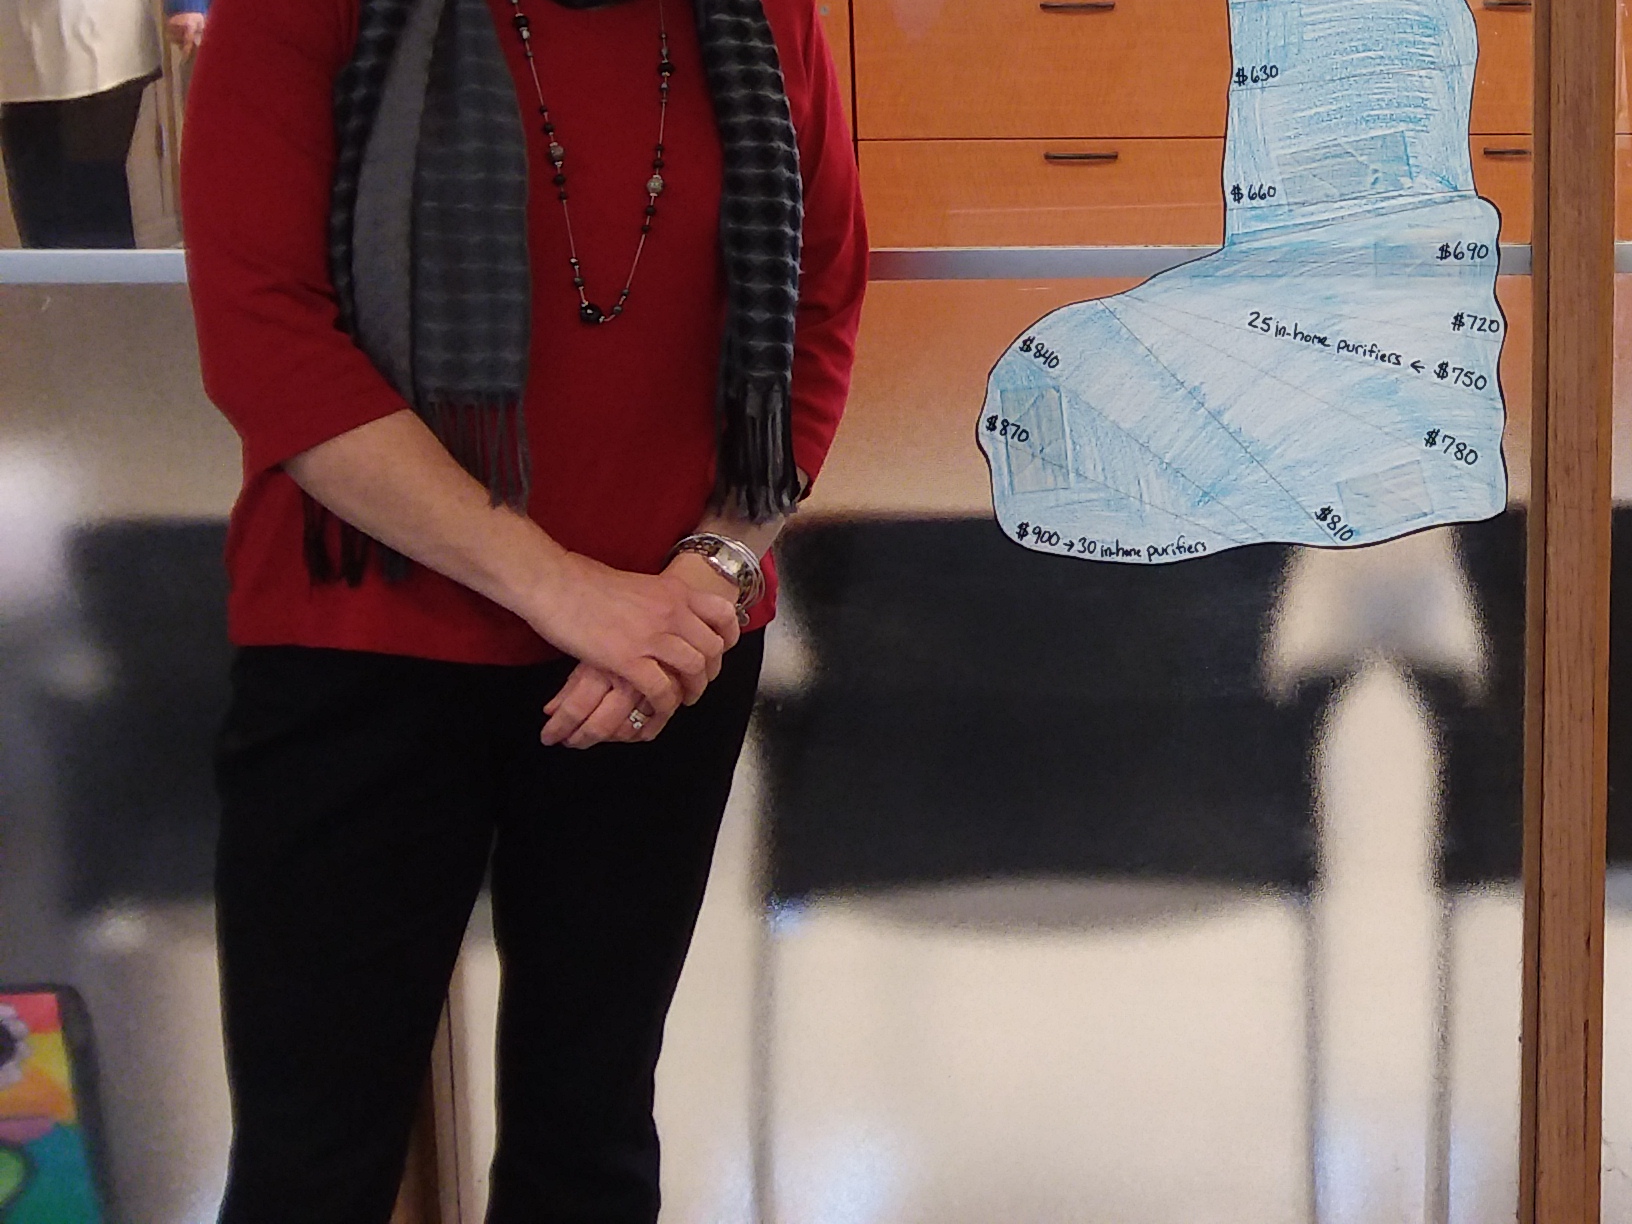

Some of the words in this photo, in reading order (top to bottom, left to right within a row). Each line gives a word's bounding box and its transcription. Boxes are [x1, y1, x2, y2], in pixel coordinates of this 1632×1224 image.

[1233, 65, 1279, 86] $630
[1230, 184, 1276, 203] $660
[1436, 241, 1488, 261] $690
[1451, 312, 1500, 333] $720
[1019, 336, 1059, 369] $840
[1248, 311, 1271, 332] 25
[1275, 321, 1331, 348] in-home
[1336, 340, 1402, 366] purifiers
[1433, 361, 1487, 390] $750
[985, 415, 1030, 443] $870
[1424, 429, 1478, 465] $780
[1315, 506, 1354, 541] $810
[1016, 522, 1060, 546] $900
[1077, 537, 1097, 554] 30
[1100, 539, 1141, 558] in-home
[1147, 534, 1207, 562] purifiers
